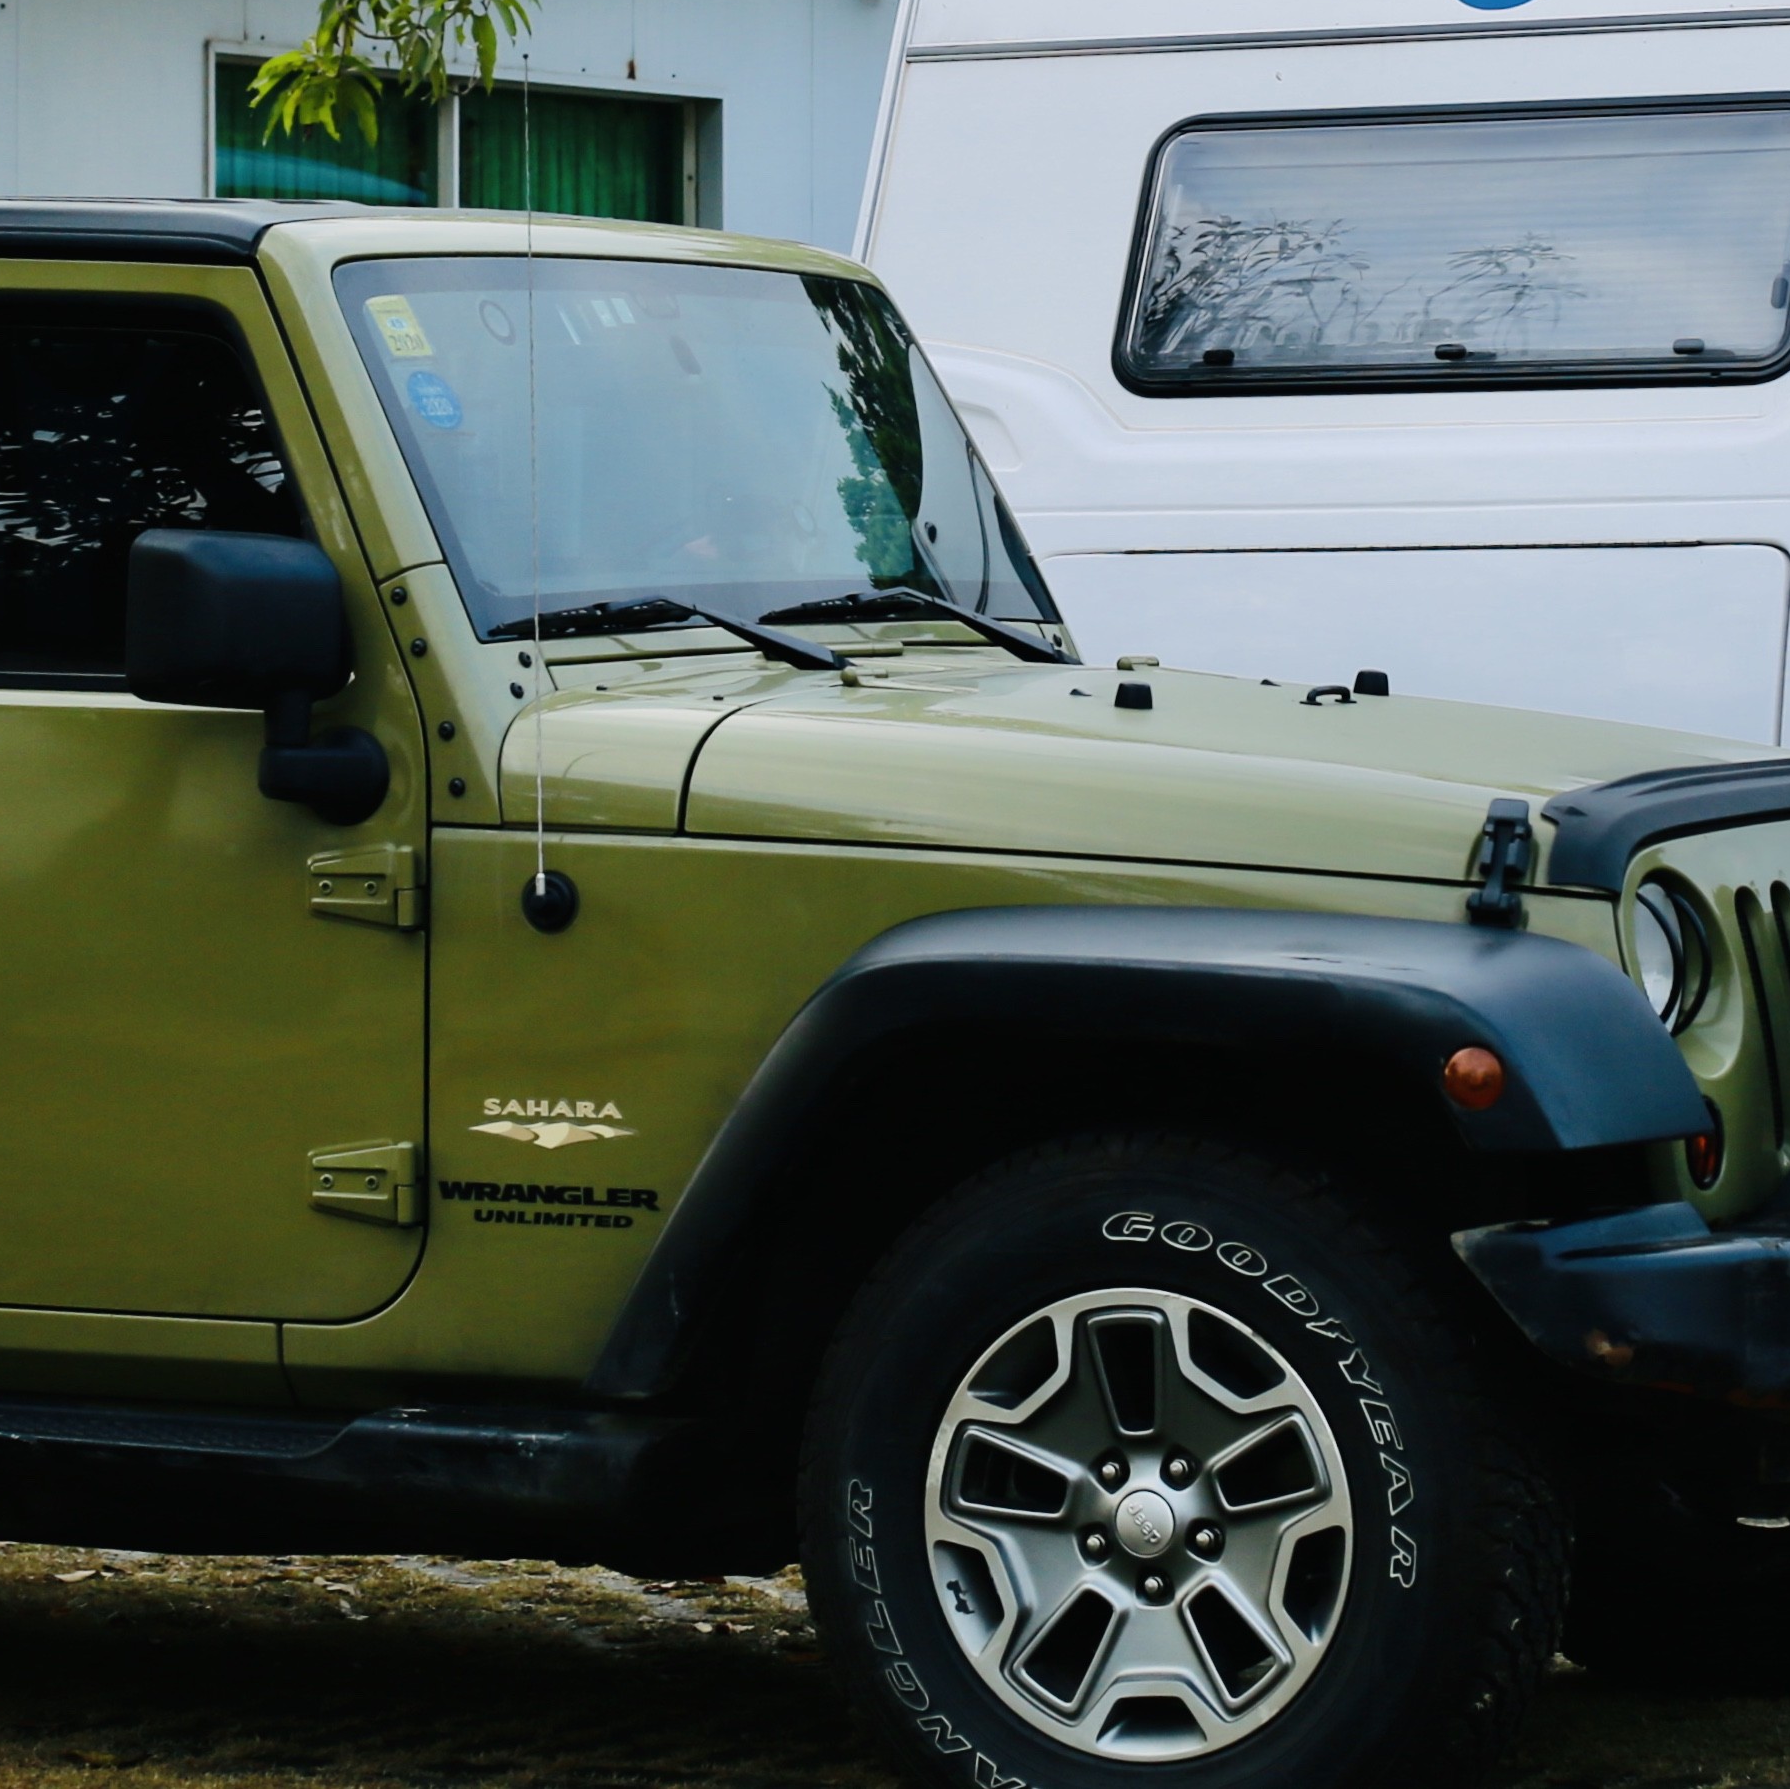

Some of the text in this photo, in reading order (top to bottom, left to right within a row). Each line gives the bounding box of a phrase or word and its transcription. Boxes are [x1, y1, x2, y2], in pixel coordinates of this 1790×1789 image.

[483, 1097, 623, 1120] SAHARA
[438, 1180, 660, 1210] WRANGLER
[473, 1208, 633, 1229] UNLIMITED
[1102, 1210, 1417, 1589] GOODYEAR
[1127, 1503, 1161, 1543] Jeep
[847, 1478, 1029, 1789] ANGLER
